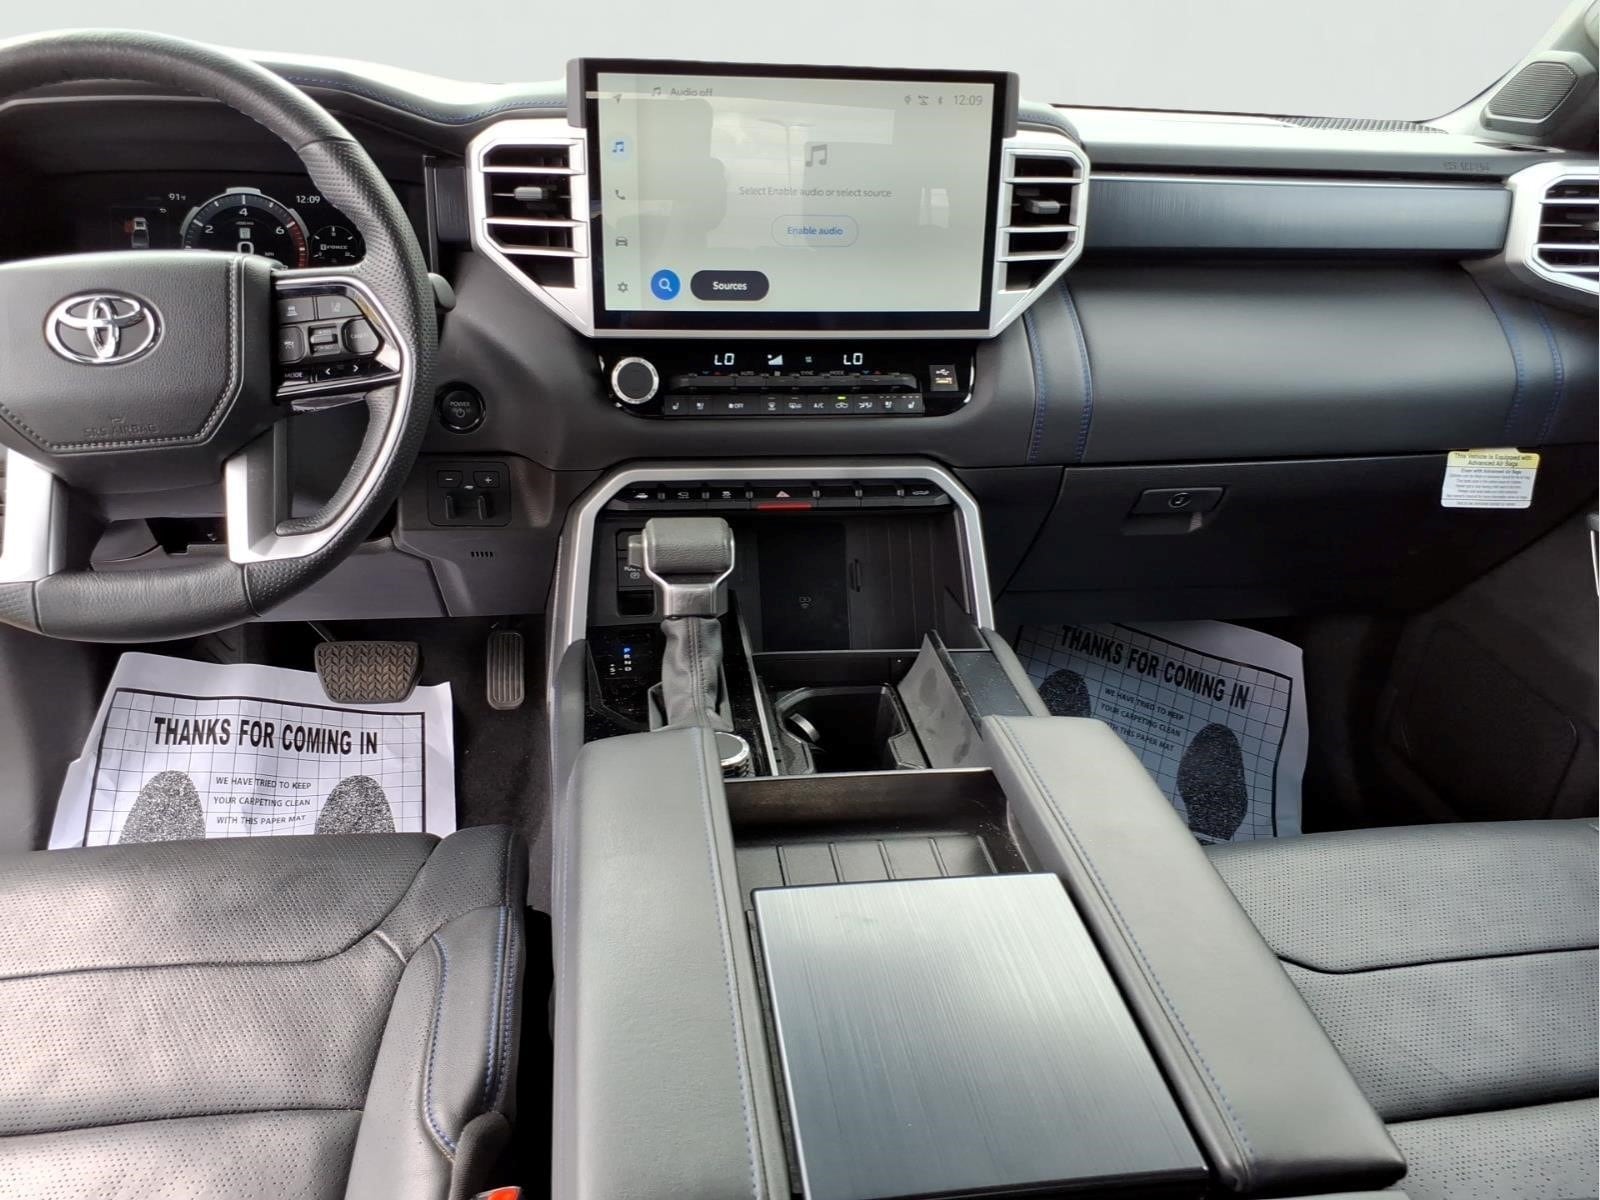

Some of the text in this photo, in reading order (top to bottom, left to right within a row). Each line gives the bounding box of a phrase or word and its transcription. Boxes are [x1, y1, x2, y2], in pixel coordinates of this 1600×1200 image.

[671, 87, 714, 97] Audio off
[953, 95, 983, 106] 12:09
[738, 186, 767, 196] Select
[801, 187, 824, 197] audio
[825, 189, 836, 197] or
[837, 187, 863, 198] select
[863, 190, 893, 198] source
[296, 194, 321, 204] 12:09
[239, 207, 248, 217] 4
[204, 225, 214, 234] 2
[275, 226, 285, 235] 6
[786, 225, 844, 236] Enable audio
[712, 280, 748, 291] Sources
[1061, 624, 1250, 710] THANKS FOR COMING IN
[1105, 687, 1184, 721] WE HAVE TRIED TO KEEP
[1101, 702, 1181, 737] YOUR CARPETING CLEAN
[154, 716, 378, 755] THANKS FOR COMING IN
[1120, 726, 1135, 738] THIS
[1136, 732, 1158, 746] PAPER
[1158, 741, 1175, 752] MAT
[215, 776, 312, 790] WE HAVE TRIED TO KEEP
[213, 796, 311, 807] YOUR CARPETING CLEAN
[216, 814, 307, 825] WITH THIS PAPER MAT
